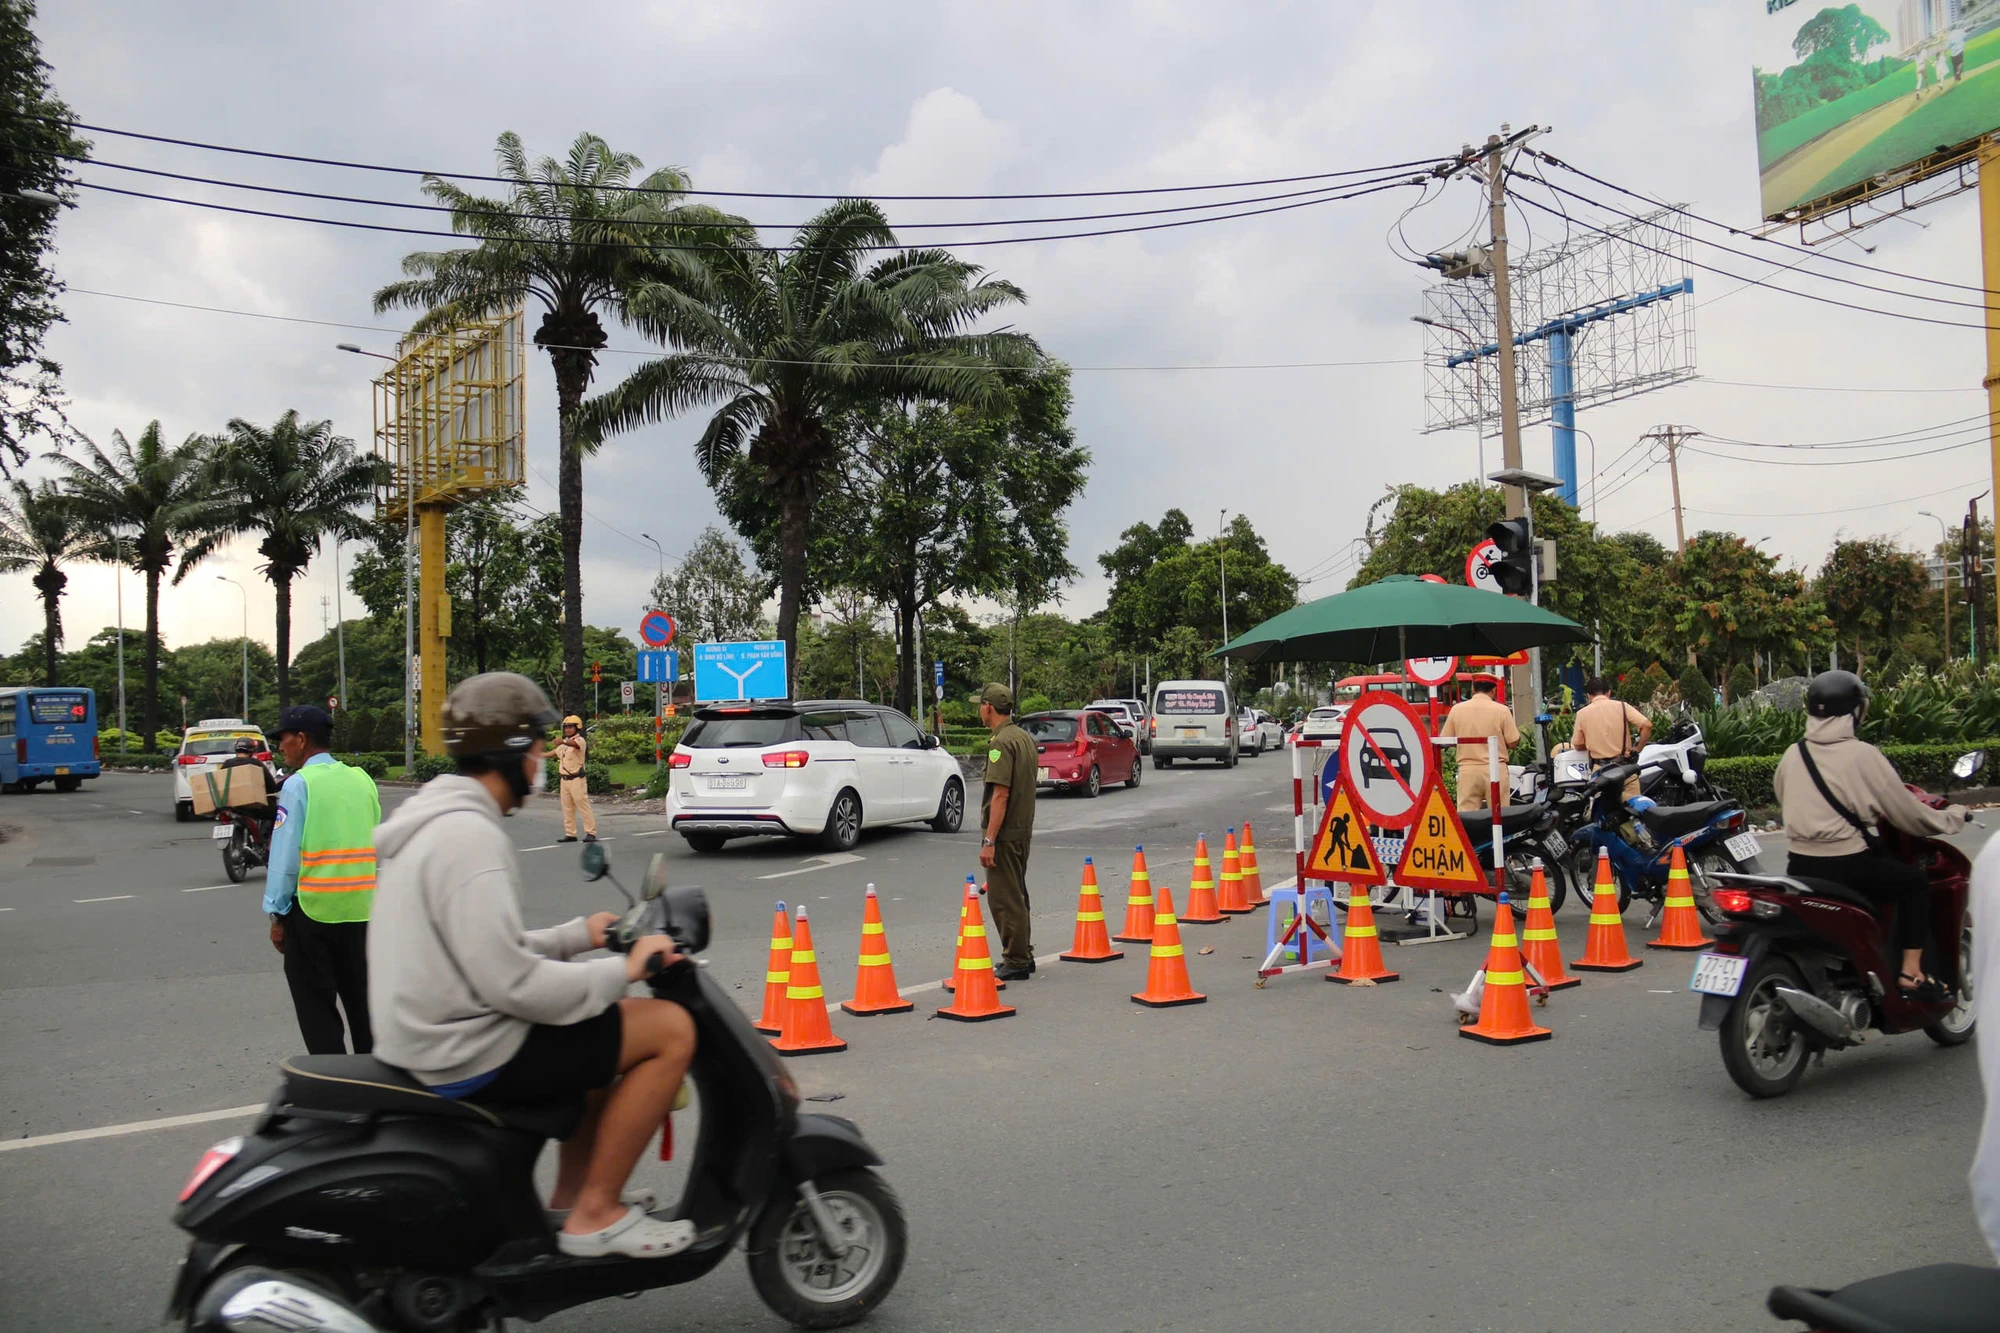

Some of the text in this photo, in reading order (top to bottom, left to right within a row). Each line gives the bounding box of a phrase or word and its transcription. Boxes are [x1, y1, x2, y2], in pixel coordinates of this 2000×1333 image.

[71, 705, 85, 715] 43
[1428, 815, 1446, 838] ĐI
[1702, 956, 1738, 975] 77-C1
